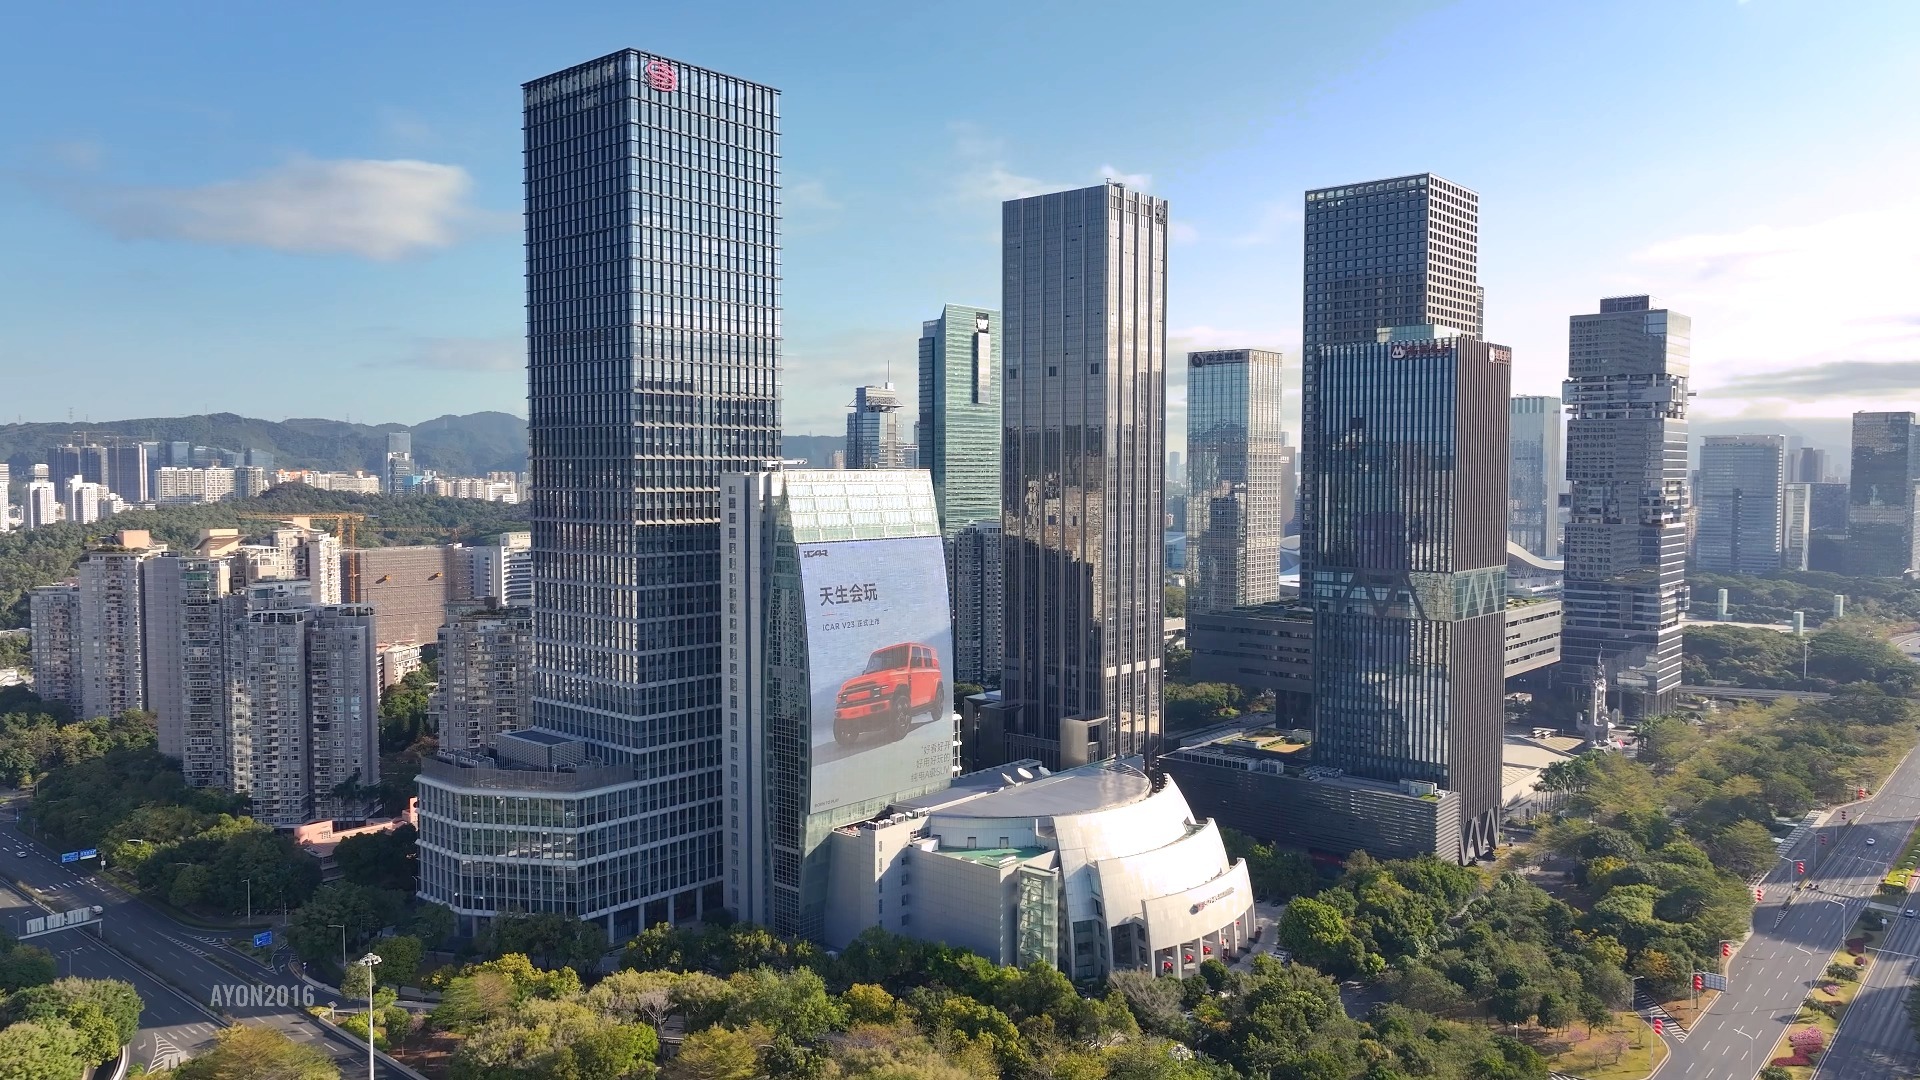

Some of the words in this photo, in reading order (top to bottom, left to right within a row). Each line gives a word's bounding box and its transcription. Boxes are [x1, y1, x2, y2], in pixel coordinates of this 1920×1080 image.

[820, 583, 878, 606] 天生会玩
[842, 620, 855, 629] V23
